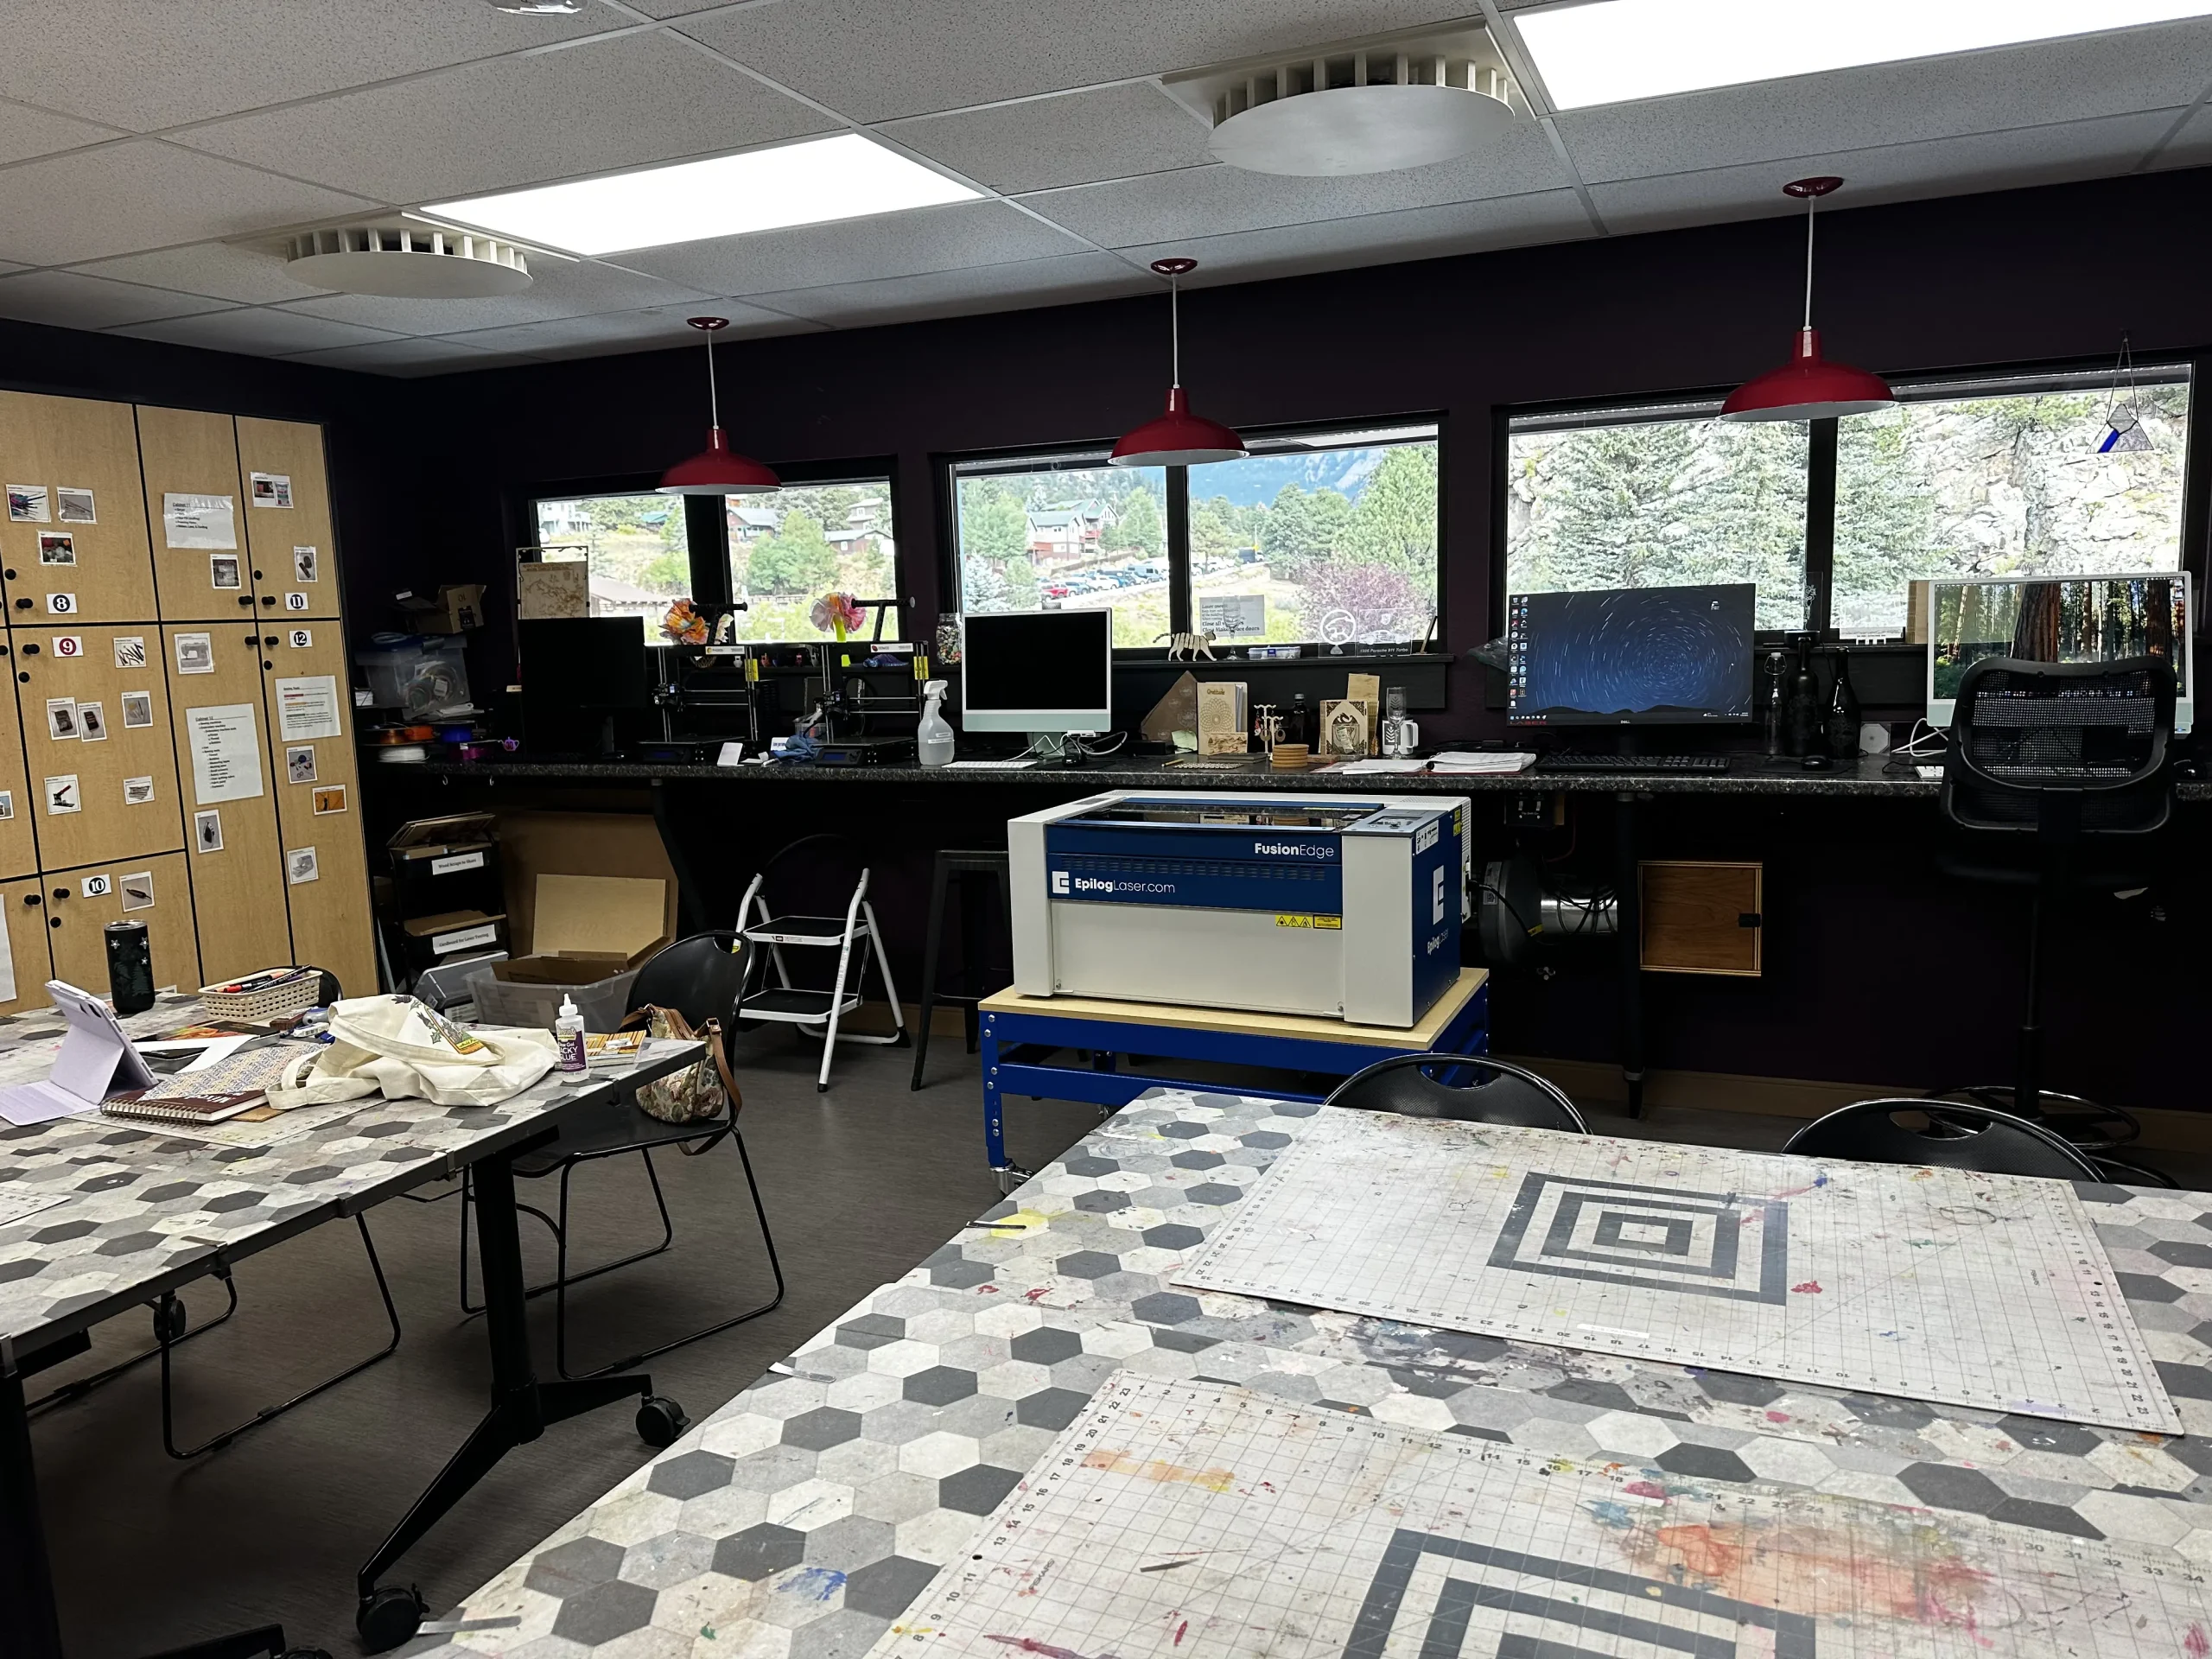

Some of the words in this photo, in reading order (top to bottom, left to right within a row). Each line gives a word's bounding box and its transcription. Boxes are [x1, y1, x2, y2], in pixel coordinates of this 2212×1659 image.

[56, 596, 66, 610] 8
[291, 595, 302, 607] 11
[295, 632, 307, 644] 12
[63, 641, 73, 652] 9
[1255, 842, 1334, 859] FusionEdge
[90, 880, 104, 893] 10
[1075, 878, 1175, 893] EpilogLaser.com
[1119, 1388, 1131, 1396] 23
[1109, 1401, 1121, 1410] 22
[1097, 1414, 1109, 1424] 21
[1086, 1428, 1098, 1438] 20
[1074, 1443, 1086, 1452] 19
[1062, 1458, 1074, 1466] 18
[1050, 1472, 1061, 1481] 17
[1036, 1488, 1048, 1497] 16
[1022, 1503, 1035, 1512] 15
[994, 1536, 1007, 1546] 13
[1738, 1497, 1756, 1505] 22
[1806, 1505, 1824, 1514] 24
[2025, 1542, 2044, 1552] 30
[2063, 1550, 2082, 1560] 31
[2102, 1558, 2122, 1568] 32
[2142, 1566, 2164, 1576] 33
[2183, 1573, 2205, 1583] 34
[963, 1573, 977, 1582] 11
[946, 1592, 960, 1602] 10
